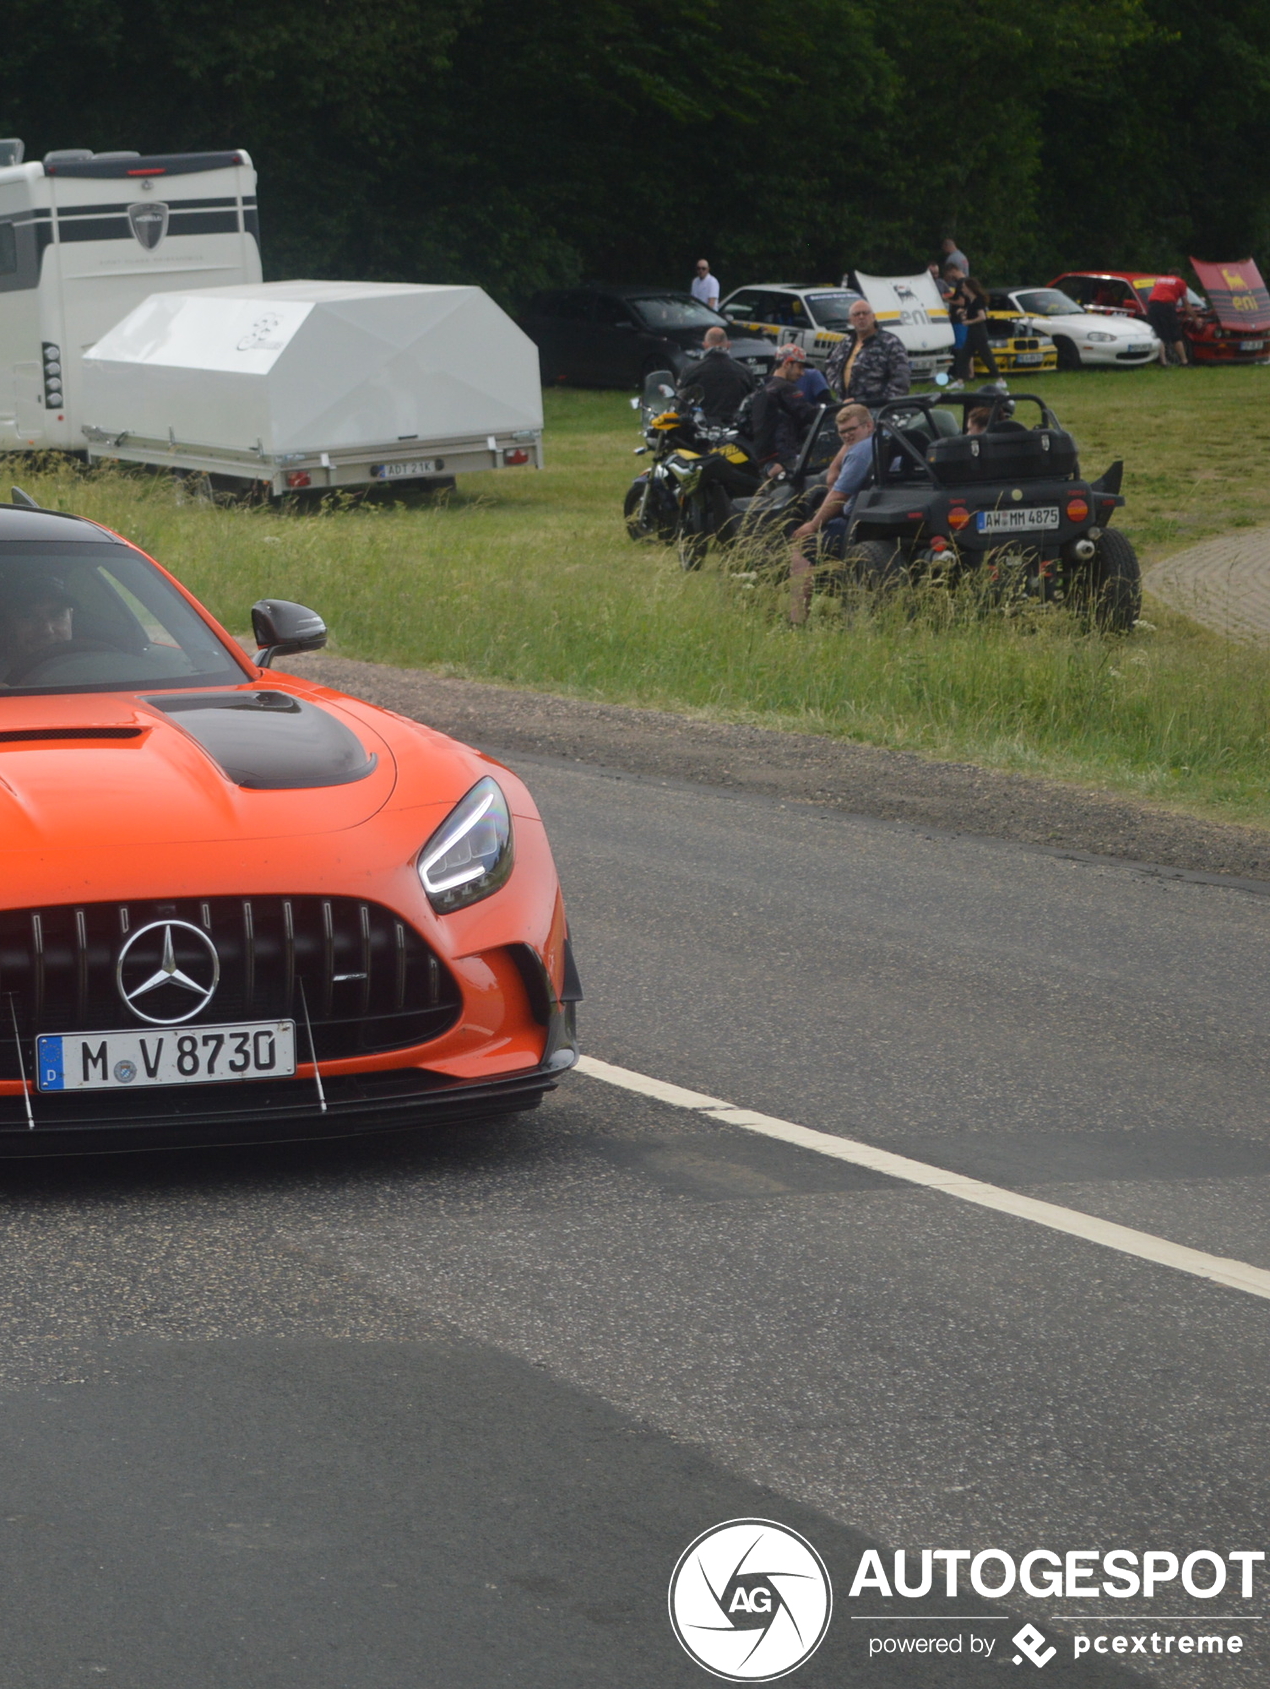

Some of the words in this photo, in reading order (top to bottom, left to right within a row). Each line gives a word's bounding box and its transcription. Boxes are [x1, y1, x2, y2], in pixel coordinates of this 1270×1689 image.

[900, 307, 930, 326] eni
[788, 332, 799, 344] 7
[388, 464, 407, 475] ADT
[986, 513, 1001, 528] AW
[1010, 511, 1025, 526] MM
[1028, 509, 1058, 524] 4875
[81, 1040, 108, 1082] M
[139, 1037, 164, 1078] V
[176, 1030, 276, 1076] 8730
[46, 1069, 57, 1082] D
